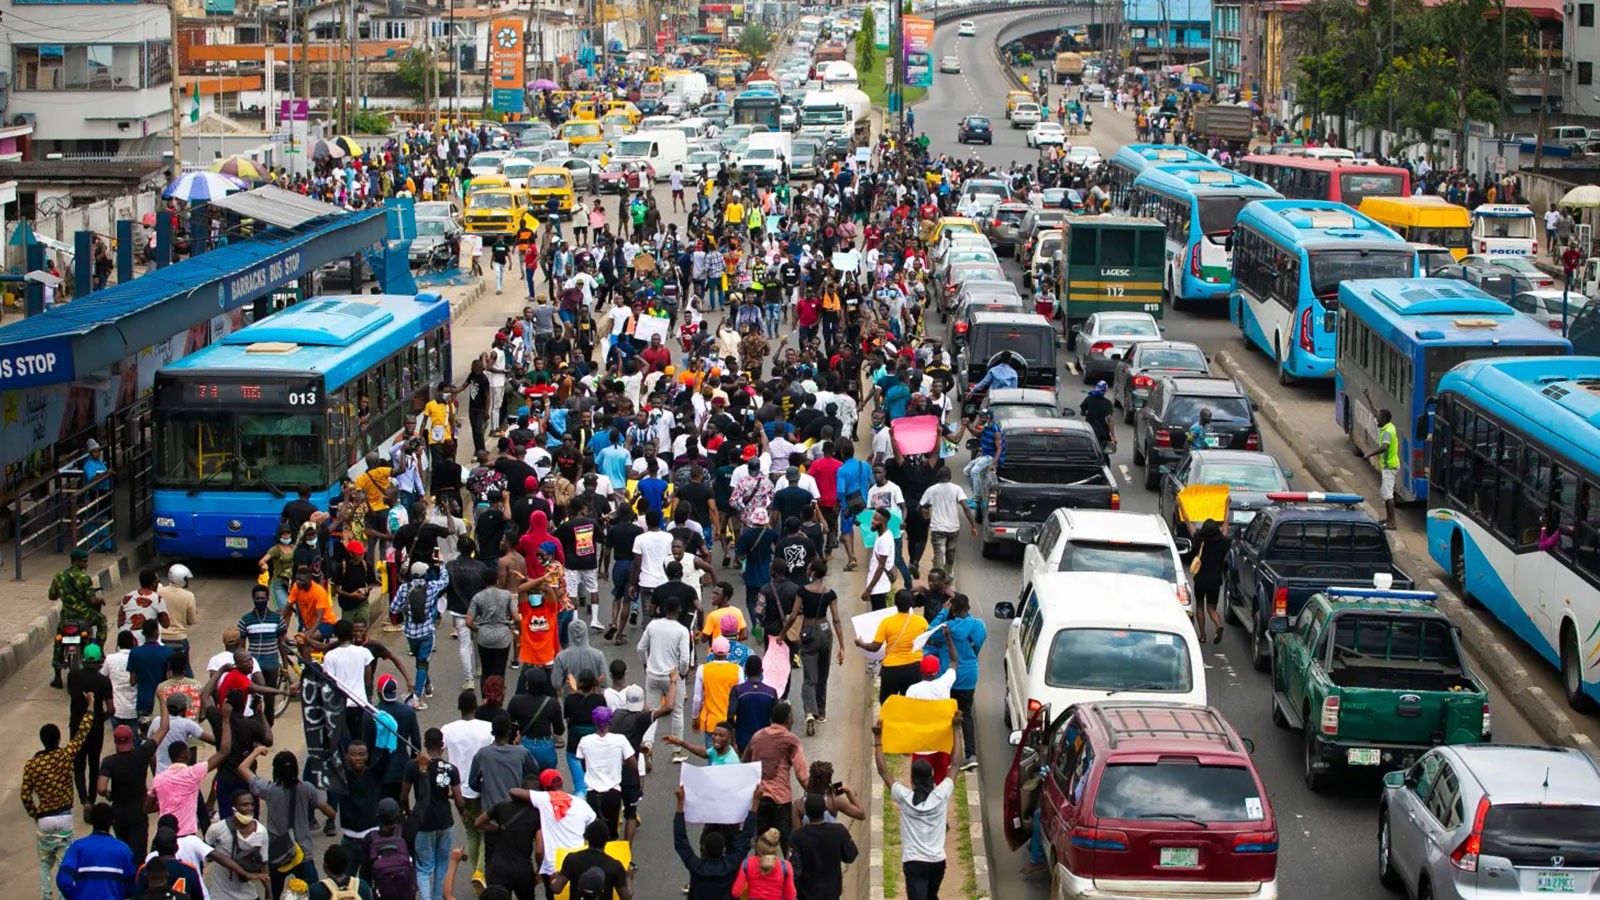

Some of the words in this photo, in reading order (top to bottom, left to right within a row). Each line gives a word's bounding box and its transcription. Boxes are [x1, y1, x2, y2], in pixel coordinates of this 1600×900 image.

[231, 268, 266, 301] BARRACKS
[269, 260, 283, 283] BUS
[284, 252, 300, 276] STOP
[1101, 269, 1130, 277] LAGESC
[1106, 288, 1125, 297] 112
[16, 352, 56, 377] STOP
[289, 392, 316, 405] 013
